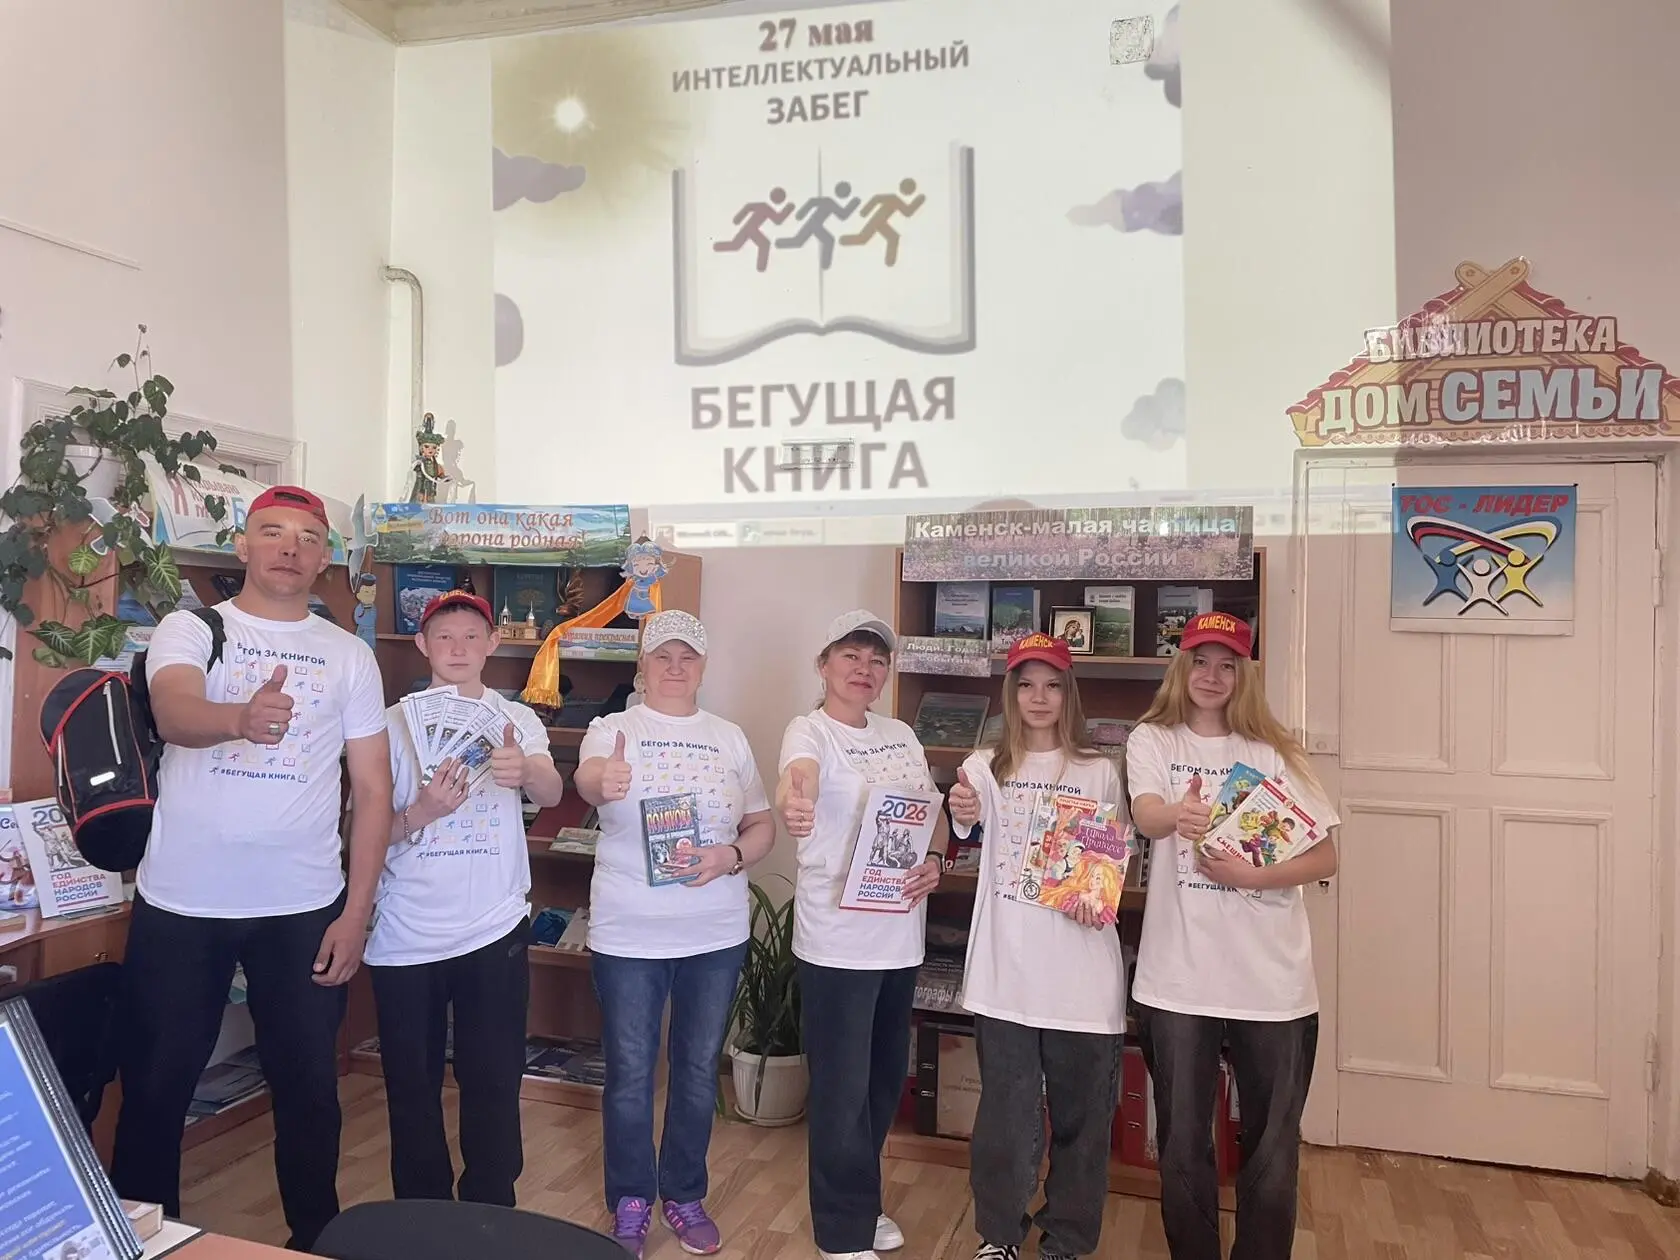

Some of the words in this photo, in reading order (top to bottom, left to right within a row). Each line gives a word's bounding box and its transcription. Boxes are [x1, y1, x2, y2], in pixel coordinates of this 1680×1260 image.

[759, 18, 797, 52] 27
[808, 19, 874, 48] мая
[672, 40, 970, 93] ИНТЕЛЛЕКТУАЛЬНЫЙ
[767, 90, 869, 125] ЗАБЕГ
[1365, 317, 1617, 362] БИБЛИОТЕКА
[691, 376, 955, 431] БЕГУЩАЯ
[1318, 382, 1432, 435] ДОМ
[1441, 367, 1664, 424] СЕМЬИ
[723, 441, 929, 494] КНИГА
[1400, 494, 1452, 514] ТОС
[1472, 494, 1569, 516] ЛИДЕР
[429, 507, 470, 525] Вот
[476, 510, 509, 525] она
[516, 511, 574, 531] какая
[915, 518, 1112, 539] Каменск-малая
[1122, 516, 1236, 537] чатица
[964, 550, 1069, 568] великой
[1078, 548, 1178, 567] России
[1198, 615, 1236, 632] КАМЕНСК
[1019, 634, 1054, 650] КАМЕНСК
[264, 649, 277, 658] ЗА
[281, 651, 326, 666] КНИГОЙ
[641, 740, 670, 748] БЕГОМ
[686, 742, 720, 754] КНИГОЙ
[220, 769, 267, 780] #БЕГУЩАЯ
[268, 772, 296, 781] КНИГА
[1171, 763, 1201, 775] БЕГОМ
[1204, 768, 1218, 776] ЗА
[1002, 780, 1029, 789] ЕГОМ
[1030, 782, 1043, 790] ЗА
[32, 808, 64, 825] 20
[882, 799, 928, 821] 2026
[50, 872, 72, 881] ГОД
[861, 875, 906, 885] ЕДИНСТВА
[863, 868, 881, 876] ГОД
[52, 873, 107, 889] ЕДИНСТВА
[54, 881, 103, 896] НАРОДОВ
[859, 883, 901, 893] НАРОДОВ
[56, 890, 98, 902] РОССИИ
[857, 890, 894, 899] РОССИИ
